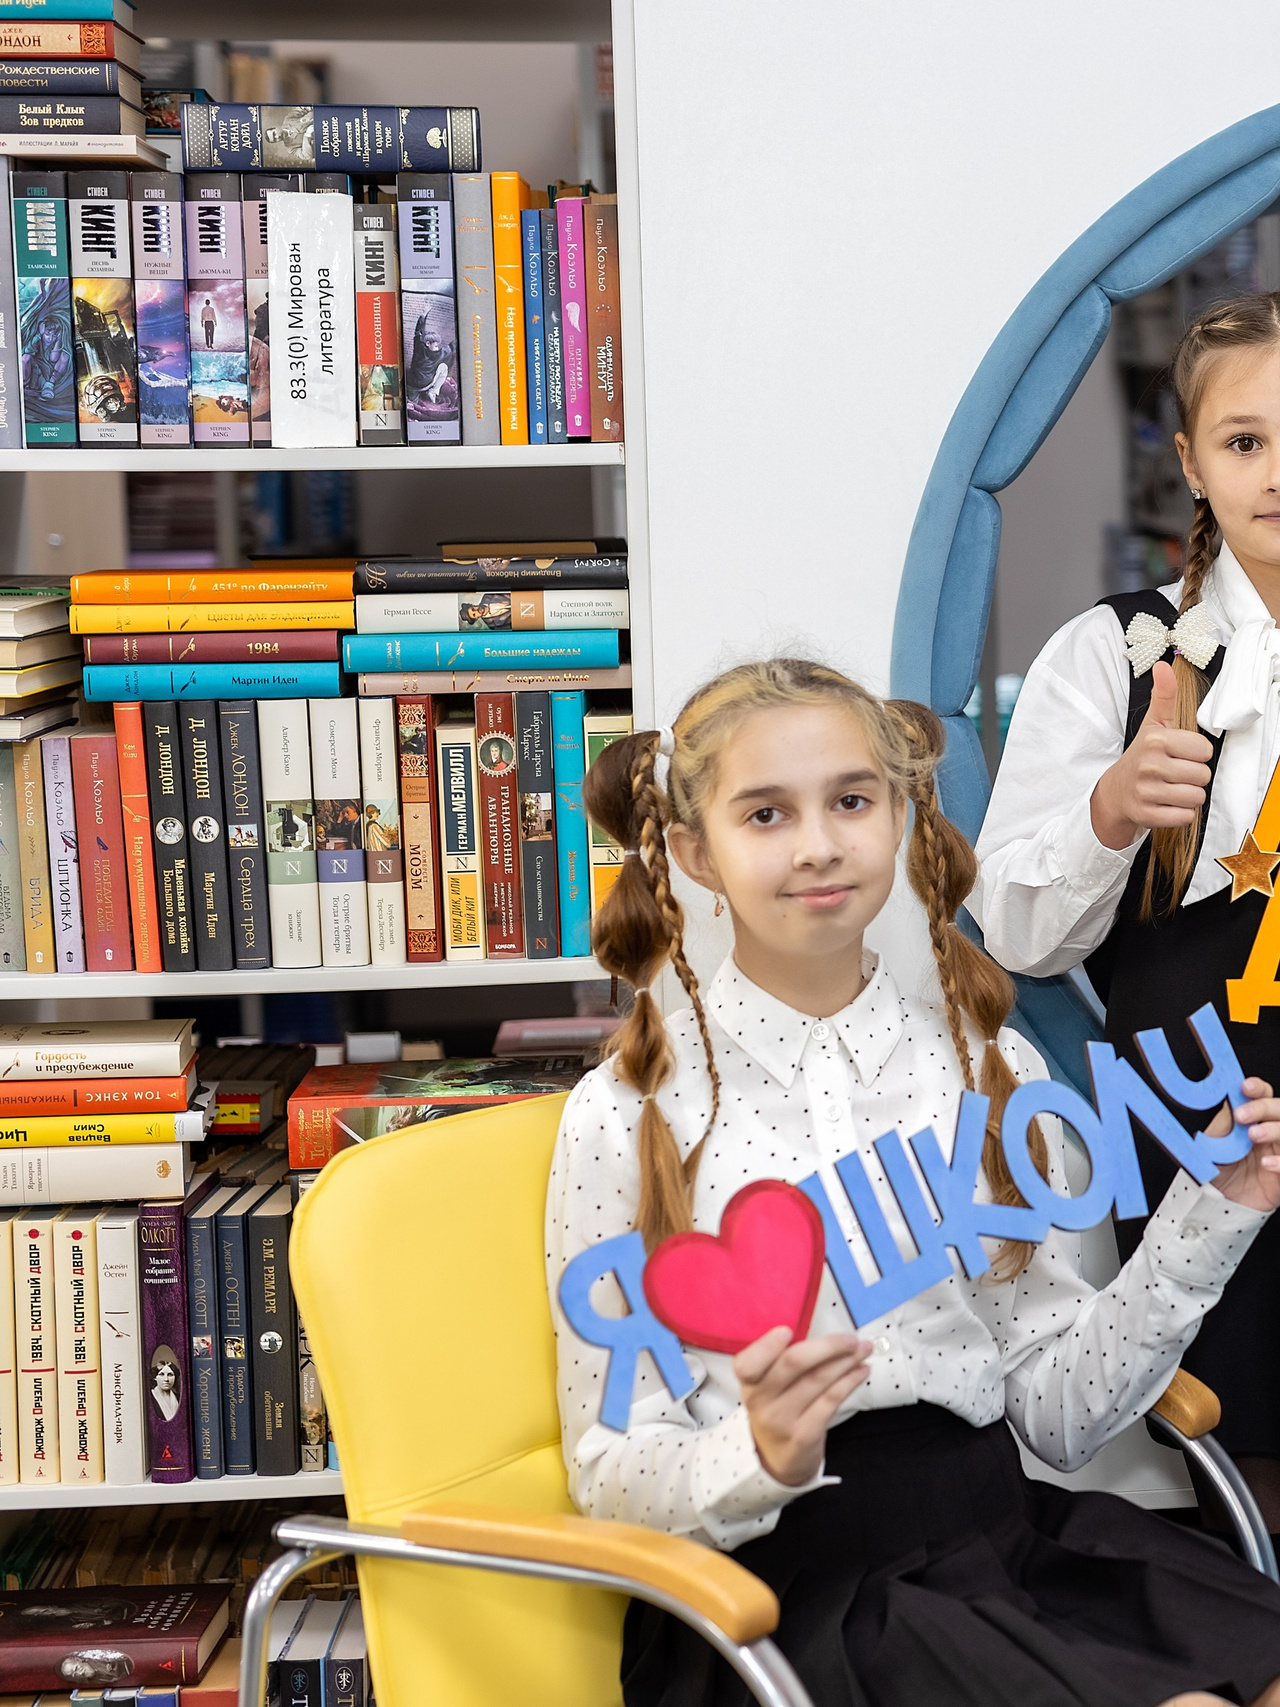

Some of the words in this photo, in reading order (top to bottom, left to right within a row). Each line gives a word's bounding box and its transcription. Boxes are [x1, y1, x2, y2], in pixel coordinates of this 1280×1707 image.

[0, 64, 100, 76] Рождественские
[0, 78, 48, 88] повести
[18, 104, 51, 115] Белый
[56, 104, 85, 116] Клык
[20, 116, 39, 127] Зов
[43, 117, 84, 128] предков
[218, 119, 229, 150] АРТУР
[231, 118, 240, 152] КОНАН
[242, 119, 253, 149] ДОЙЛ
[320, 119, 330, 154] Полное
[26, 187, 48, 197] СТИВЕН
[87, 187, 108, 197] СТИВЕН
[144, 189, 166, 199] СТИВЕН
[200, 189, 221, 199] СТИВЕН
[411, 189, 435, 199] СТИВЕН
[26, 202, 58, 257] КИНГ
[80, 204, 118, 259] КИНГ
[142, 205, 172, 259] КИНГ
[198, 205, 227, 260] КИНГ
[363, 216, 384, 229] СТИВЕН
[411, 205, 441, 259] КИНГ
[364, 236, 386, 286] КИНГ
[567, 243, 578, 289] Коэльо
[597, 246, 607, 292] Коэльо
[287, 243, 307, 329] Мировая
[317, 268, 337, 376] литература
[374, 295, 383, 361] БЕССОННИЦА
[503, 306, 517, 328] Над
[472, 313, 484, 358] Список
[287, 335, 309, 400] 83.3(0)
[505, 332, 517, 391] пропастью
[473, 360, 484, 420] Шиндлера
[258, 581, 328, 595] Фаренгейту
[486, 570, 517, 579] Набоков
[518, 569, 562, 579] Владимир
[383, 608, 410, 617] Герман
[550, 611, 582, 620] Нарцисс
[590, 609, 625, 619] Златоуст
[560, 601, 593, 610] Степной
[247, 642, 280, 655] 1984
[484, 647, 530, 658] Большие
[533, 647, 581, 658] надежды
[231, 675, 270, 686] Мартин
[272, 675, 299, 685] Иден
[506, 674, 545, 685] Смерть
[563, 672, 590, 682] Ниле
[159, 743, 174, 796] ЛОНДОН
[193, 737, 211, 800] ЛОНДОН
[231, 752, 249, 817] ЛОНДОН
[451, 748, 467, 814] МЕЛВИЛЛ
[93, 779, 104, 825] Коэльо
[458, 817, 469, 850] ГЕРМАН
[487, 795, 499, 865] АВАНТЮРЫ
[500, 785, 513, 874] ГРАНДИОЗНЫЕ
[238, 856, 254, 913] Сердца
[408, 843, 422, 891] МОЭМ
[29, 877, 40, 930] БРИДА
[57, 858, 73, 932] ШПИОНКА
[162, 869, 174, 917] Большого
[174, 858, 187, 920] Маленькая
[204, 871, 214, 911] Мартин
[177, 922, 189, 954] хозяйка
[207, 913, 216, 939] Иден
[243, 916, 256, 949] трех
[453, 920, 462, 943] МОБИ
[467, 915, 477, 943] БЕЛЫЙ
[35, 1052, 87, 1061] Гордость
[46, 1061, 134, 1074] предубеждение
[85, 1091, 130, 1102] ХЭНКС
[135, 1091, 161, 1100] ТОМ
[74, 1124, 105, 1133] Смил
[558, 1230, 695, 1432] Я
[796, 1002, 1253, 1329] ШКОЛУ
[140, 1227, 177, 1244] ОЛКОТТ
[262, 1237, 274, 1263] Э.М.
[29, 1243, 42, 1275] ДВОР
[72, 1245, 84, 1276] ДВОР
[102, 1262, 129, 1271] Джейн
[145, 1266, 176, 1276] собрание
[222, 1240, 232, 1274] Джейн
[143, 1275, 179, 1285] сочинений
[263, 1265, 277, 1314] РЕМАРК
[30, 1277, 43, 1332] СКОТНЫЙ
[73, 1278, 86, 1334] СКОТНЫЙ
[192, 1277, 208, 1328] ОЛКОТТ
[225, 1276, 241, 1328] ОСТЕН
[32, 1377, 44, 1416] ОРУЭЛЛ
[75, 1379, 87, 1417] ОРУЭЛЛ
[199, 1366, 211, 1423] Хорошие
[236, 1366, 246, 1404] Гордость
[111, 1362, 125, 1444] Мэнсфилд-парк
[263, 1390, 274, 1441] обетованная
[274, 1401, 284, 1429] Земля
[34, 1417, 46, 1461] ДЖОРДЖ
[77, 1418, 90, 1462] ДЖОРДЖ
[201, 1427, 212, 1461] жены
[147, 1593, 178, 1630] собрание
[160, 1590, 194, 1632] сочинений
